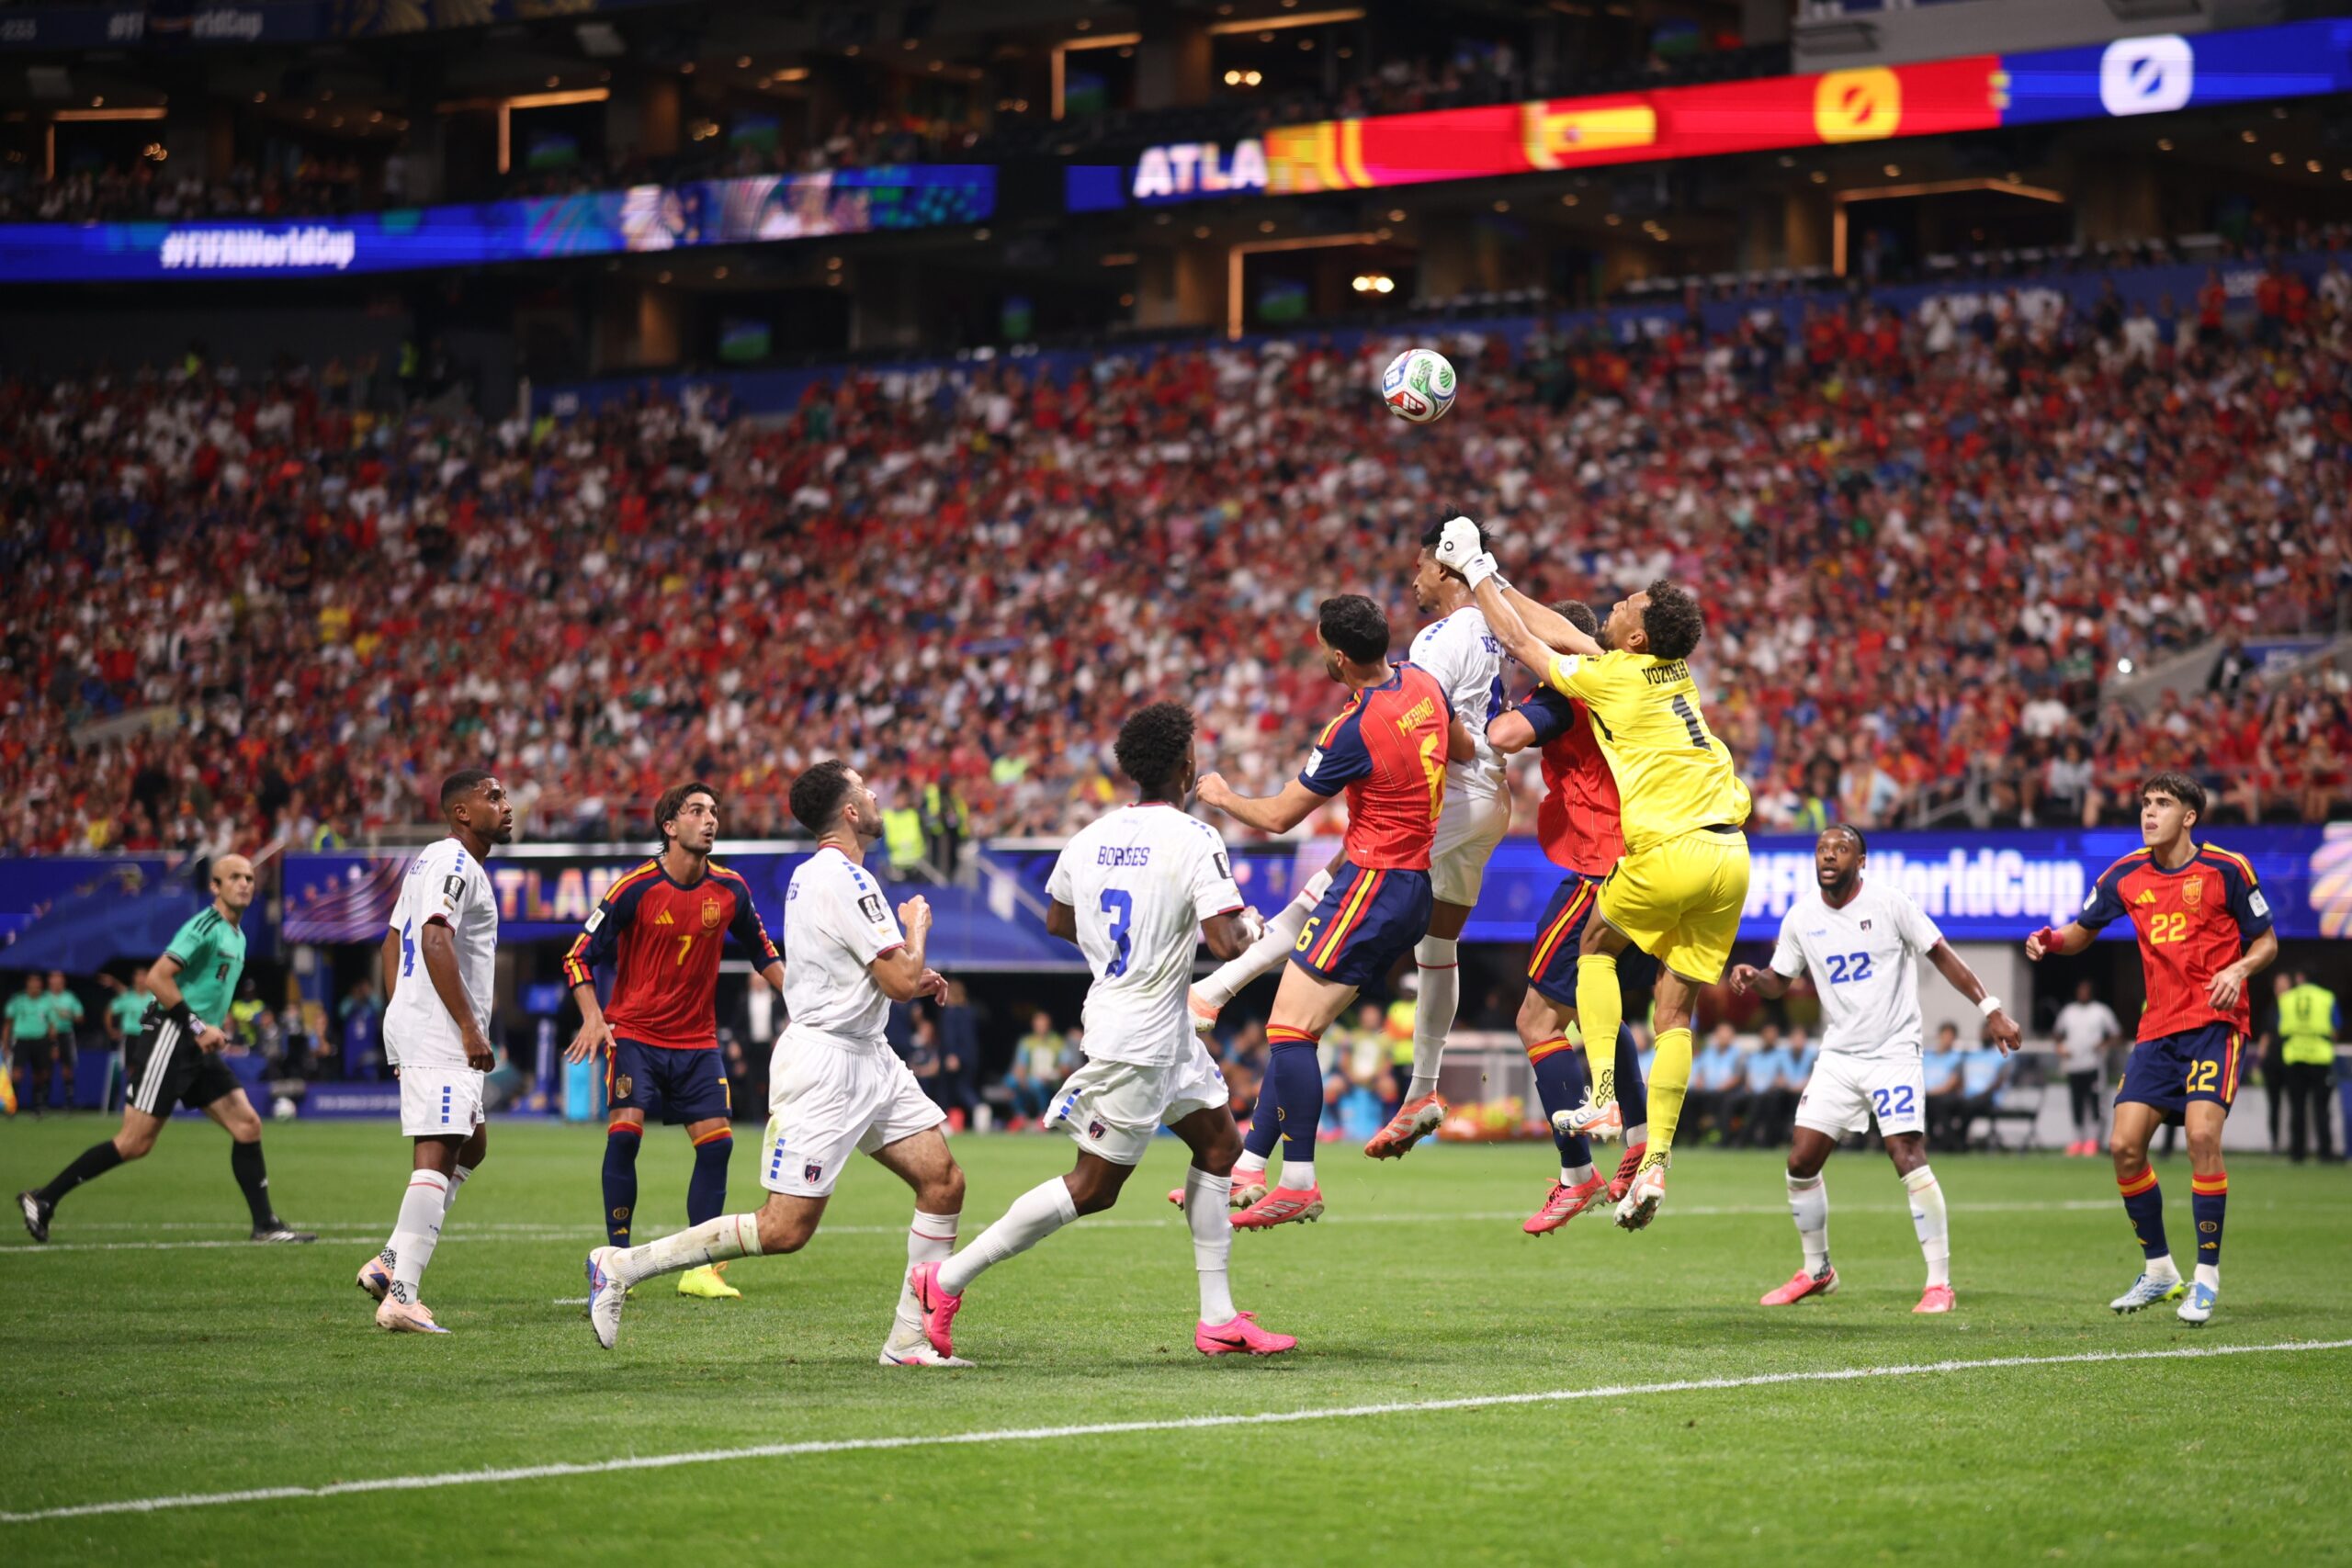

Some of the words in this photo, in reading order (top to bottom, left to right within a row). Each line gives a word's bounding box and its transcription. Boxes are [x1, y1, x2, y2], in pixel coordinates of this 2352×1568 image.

[161, 226, 356, 269] #FIFAWorldCup
[1396, 696, 1435, 737] MERINO
[1671, 694, 1712, 751] 1
[1419, 731, 1446, 821] 6
[1097, 845, 1150, 866] BORGES
[1100, 887, 1132, 977] 3
[1295, 917, 1321, 952] 6
[2149, 912, 2187, 945] 22
[676, 935, 693, 965] 7
[1826, 952, 1872, 985] 22
[718, 1077, 732, 1110] 7
[2186, 1059, 2219, 1094] 22
[1872, 1085, 1915, 1118] 22
